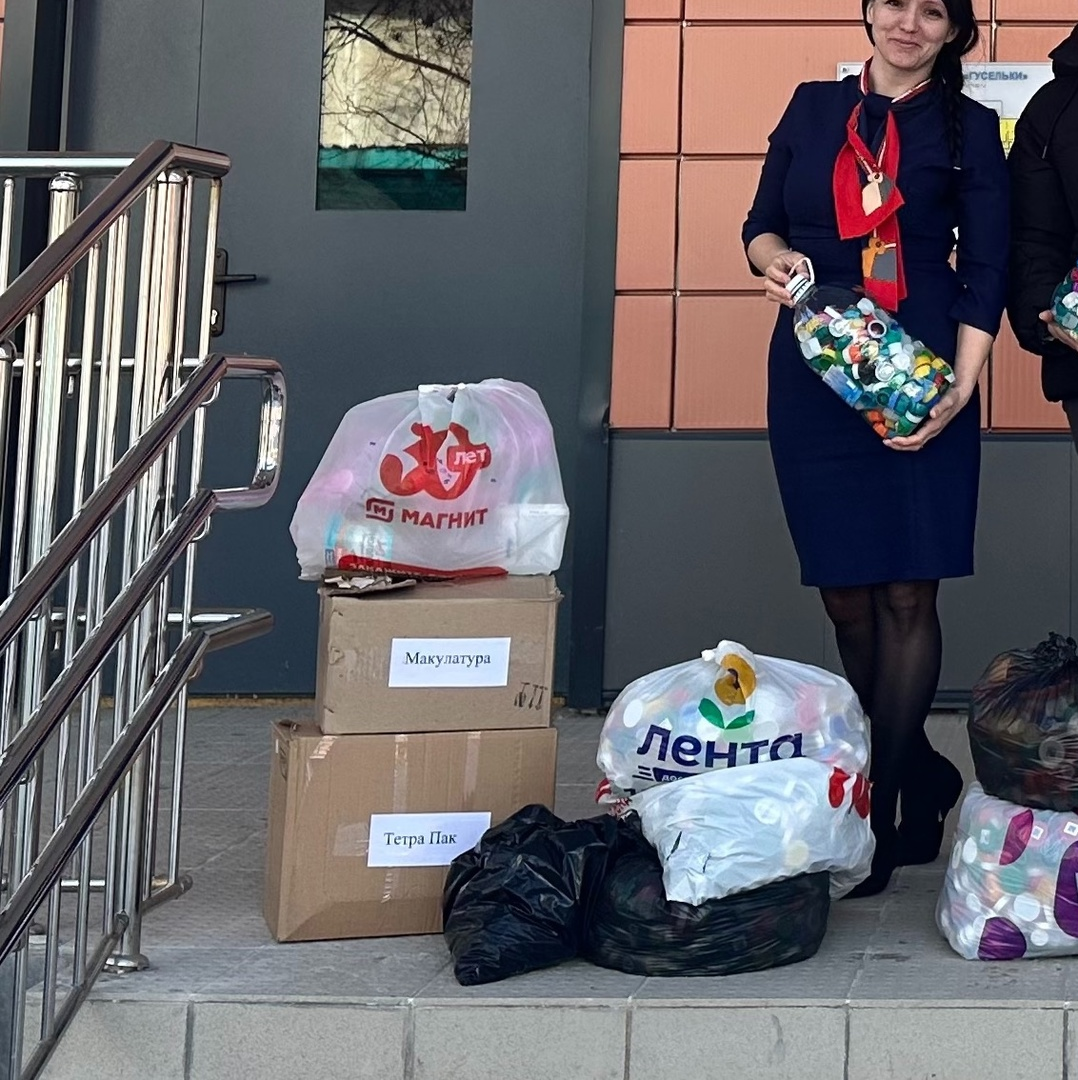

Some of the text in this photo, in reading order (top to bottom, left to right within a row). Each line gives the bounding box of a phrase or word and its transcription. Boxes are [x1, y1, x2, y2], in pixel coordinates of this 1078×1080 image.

[401, 508, 489, 530] МАГНИТ
[404, 651, 491, 668] Макулатура
[383, 831, 457, 849] Тетра Пак
